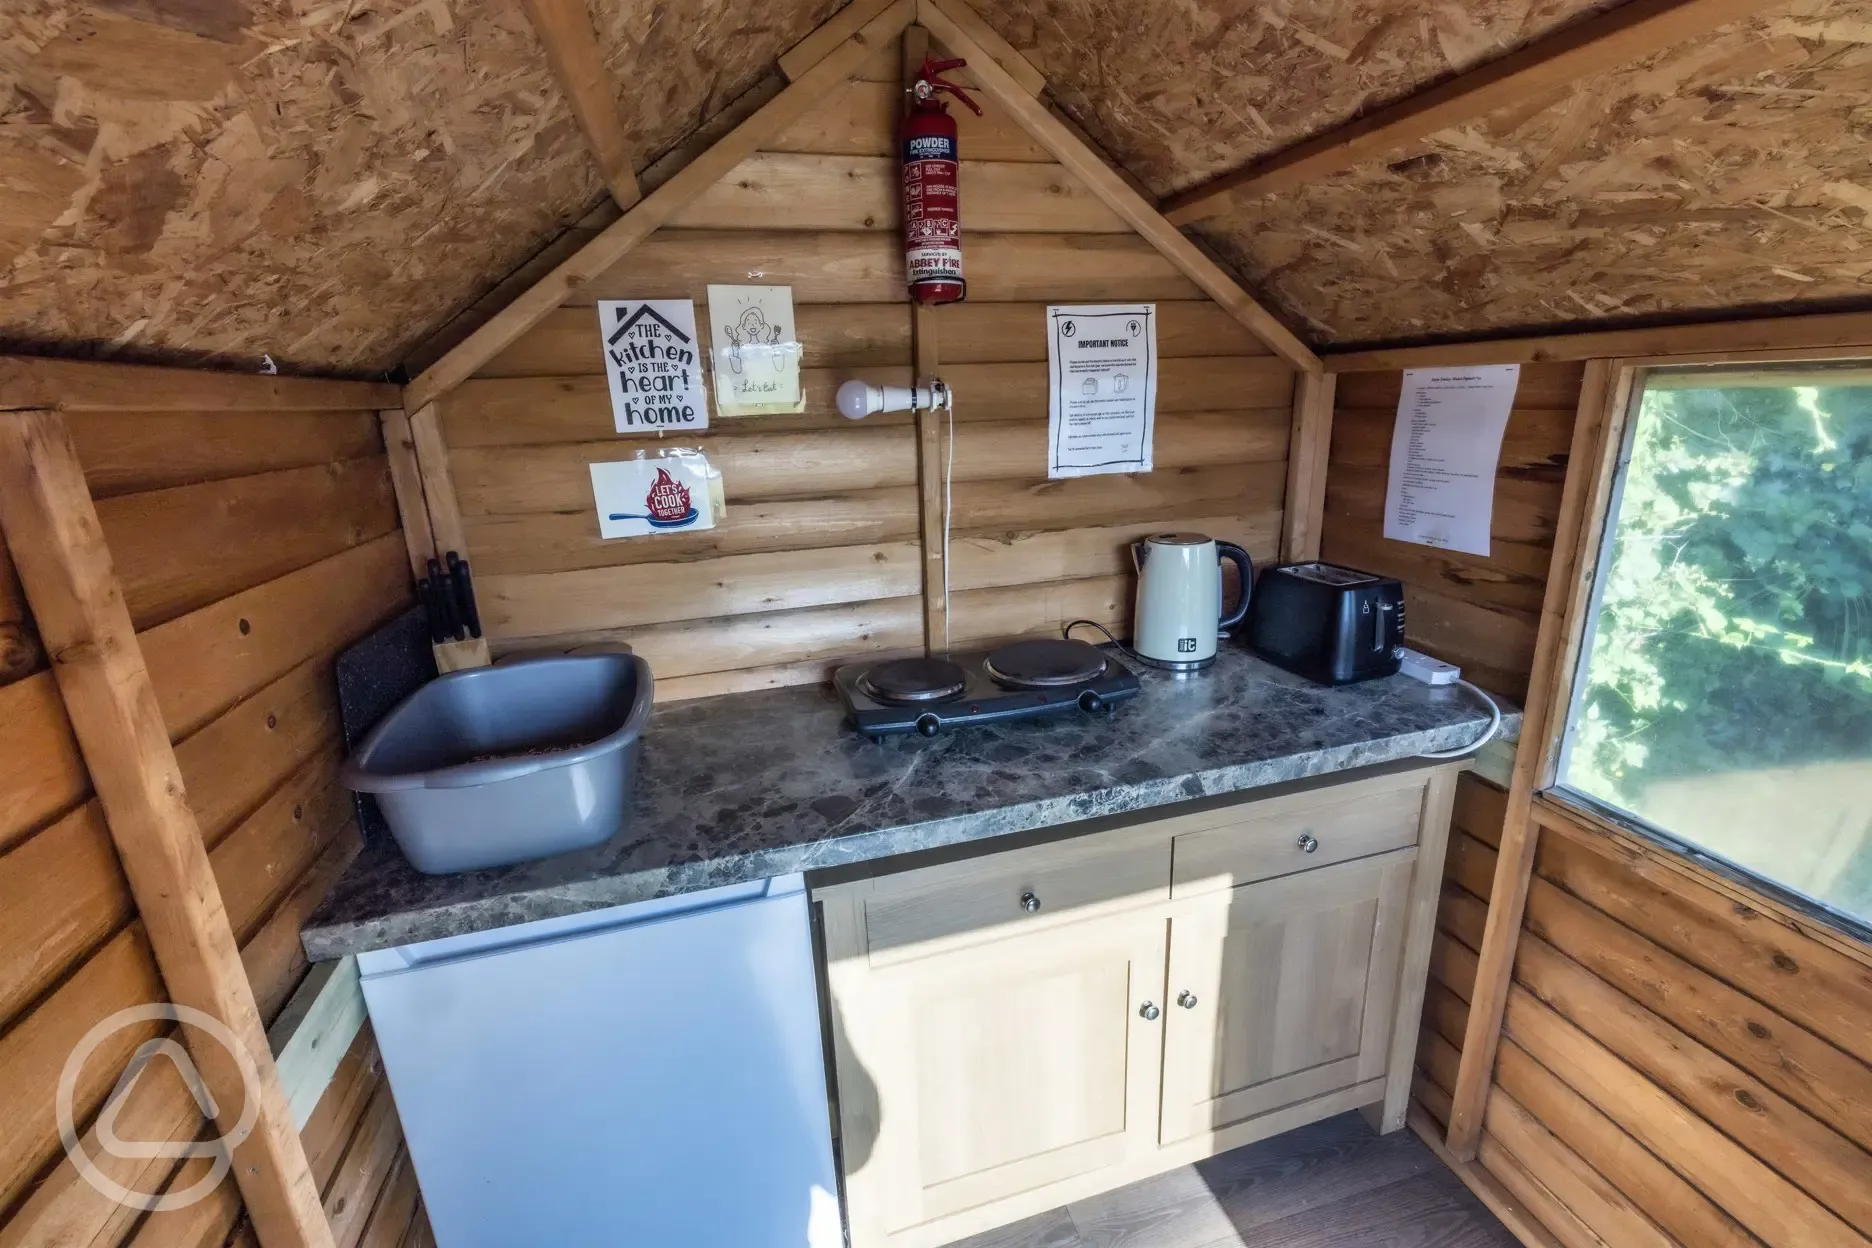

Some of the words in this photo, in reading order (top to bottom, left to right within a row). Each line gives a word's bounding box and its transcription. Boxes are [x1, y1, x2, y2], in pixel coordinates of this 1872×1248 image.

[910, 137, 950, 151] POWDER
[910, 258, 940, 269] ABBEY
[942, 257, 960, 269] FIRE
[635, 324, 661, 338] THE
[1078, 340, 1110, 349] IMPORTANT
[1111, 339, 1129, 348] NOTICE
[609, 340, 693, 367] kitchen
[638, 362, 648, 373] IS
[650, 362, 669, 373] THE
[620, 369, 690, 393] heart
[741, 379, 761, 393] Let's
[763, 381, 777, 392] Eat
[644, 395, 656, 405] OF
[658, 394, 672, 405] MY
[625, 402, 695, 425] home
[654, 494, 683, 509] COOK
[657, 507, 685, 517] TOGETHER
